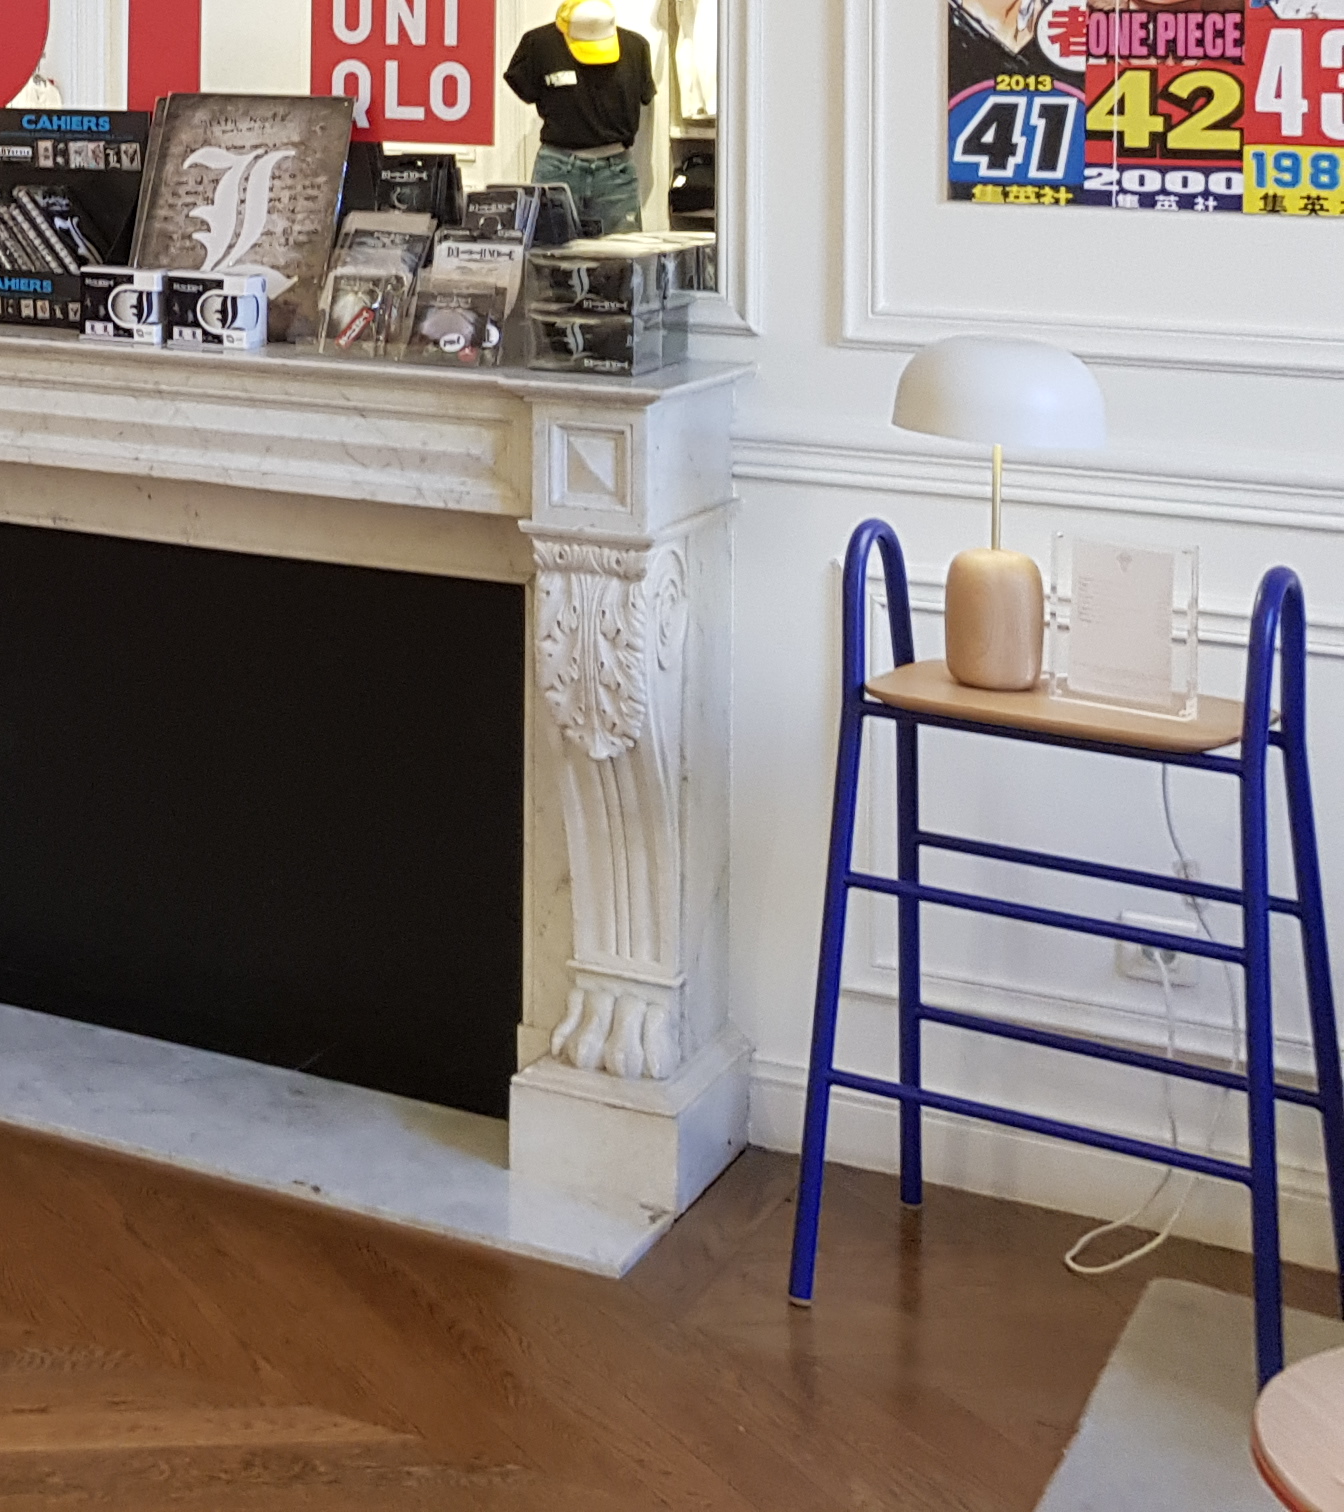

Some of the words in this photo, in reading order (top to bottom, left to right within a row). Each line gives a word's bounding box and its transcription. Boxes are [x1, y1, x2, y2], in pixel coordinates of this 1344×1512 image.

[1088, 11, 1149, 58] ONE
[1155, 12, 1242, 58] PIECE
[995, 74, 1052, 92] 2013
[21, 114, 111, 133] CAHIERS
[1086, 69, 1243, 159] 42
[954, 95, 1077, 180] 41
[1084, 168, 1243, 194] 2000
[1252, 150, 1341, 190] 198
[1258, 191, 1344, 215] 集英
